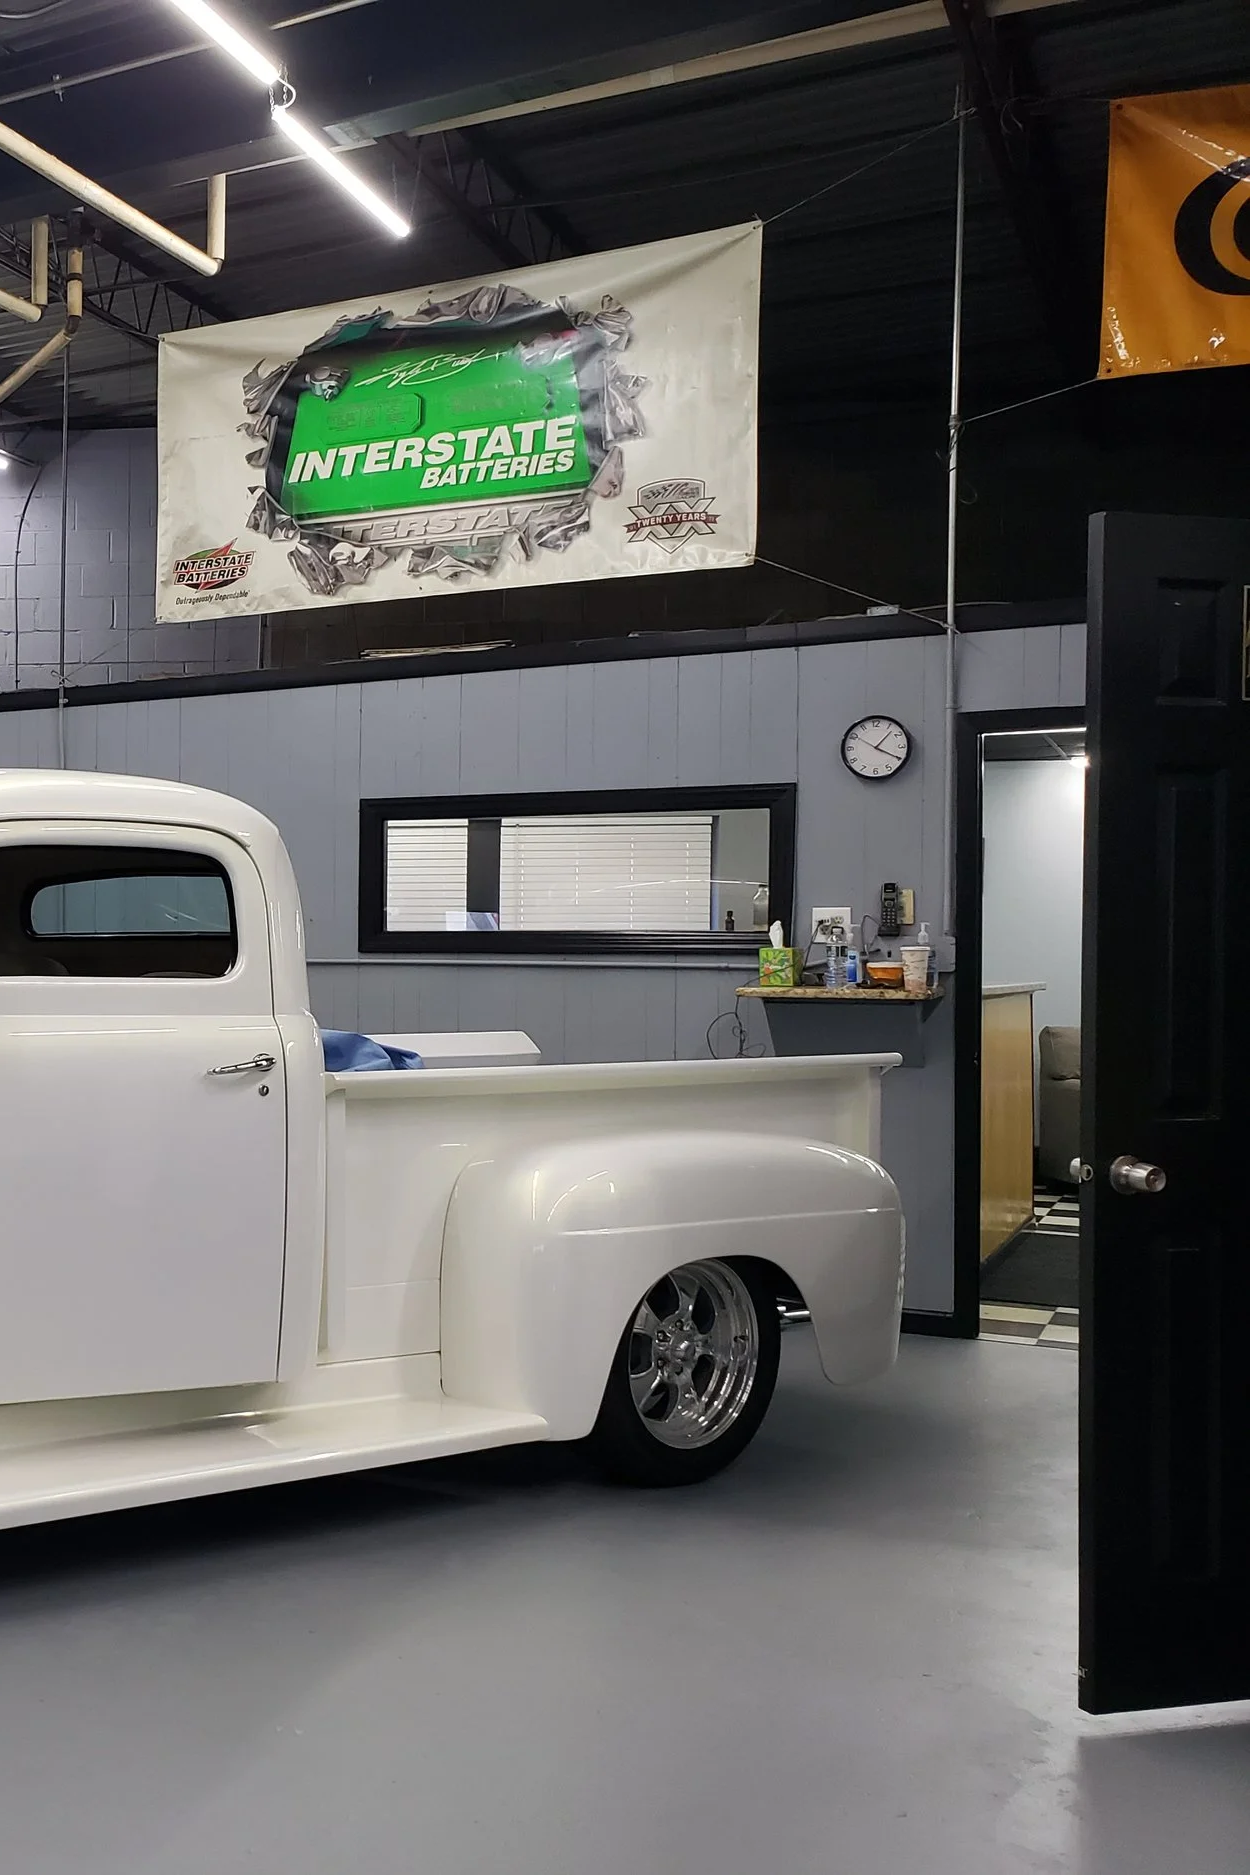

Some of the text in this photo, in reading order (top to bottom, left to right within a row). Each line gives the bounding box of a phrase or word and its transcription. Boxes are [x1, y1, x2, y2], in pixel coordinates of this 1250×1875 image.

[288, 415, 578, 485] INTERSTATE
[419, 450, 575, 490] BATTERIES
[636, 514, 674, 528] TWENTY
[675, 512, 707, 521] YEARS
[175, 553, 252, 572] INTERSTATE
[176, 566, 247, 583] BATTERIES
[860, 723, 867, 731] 11
[871, 720, 881, 728] 12
[859, 764, 867, 772] 7
[885, 763, 893, 771] 5
